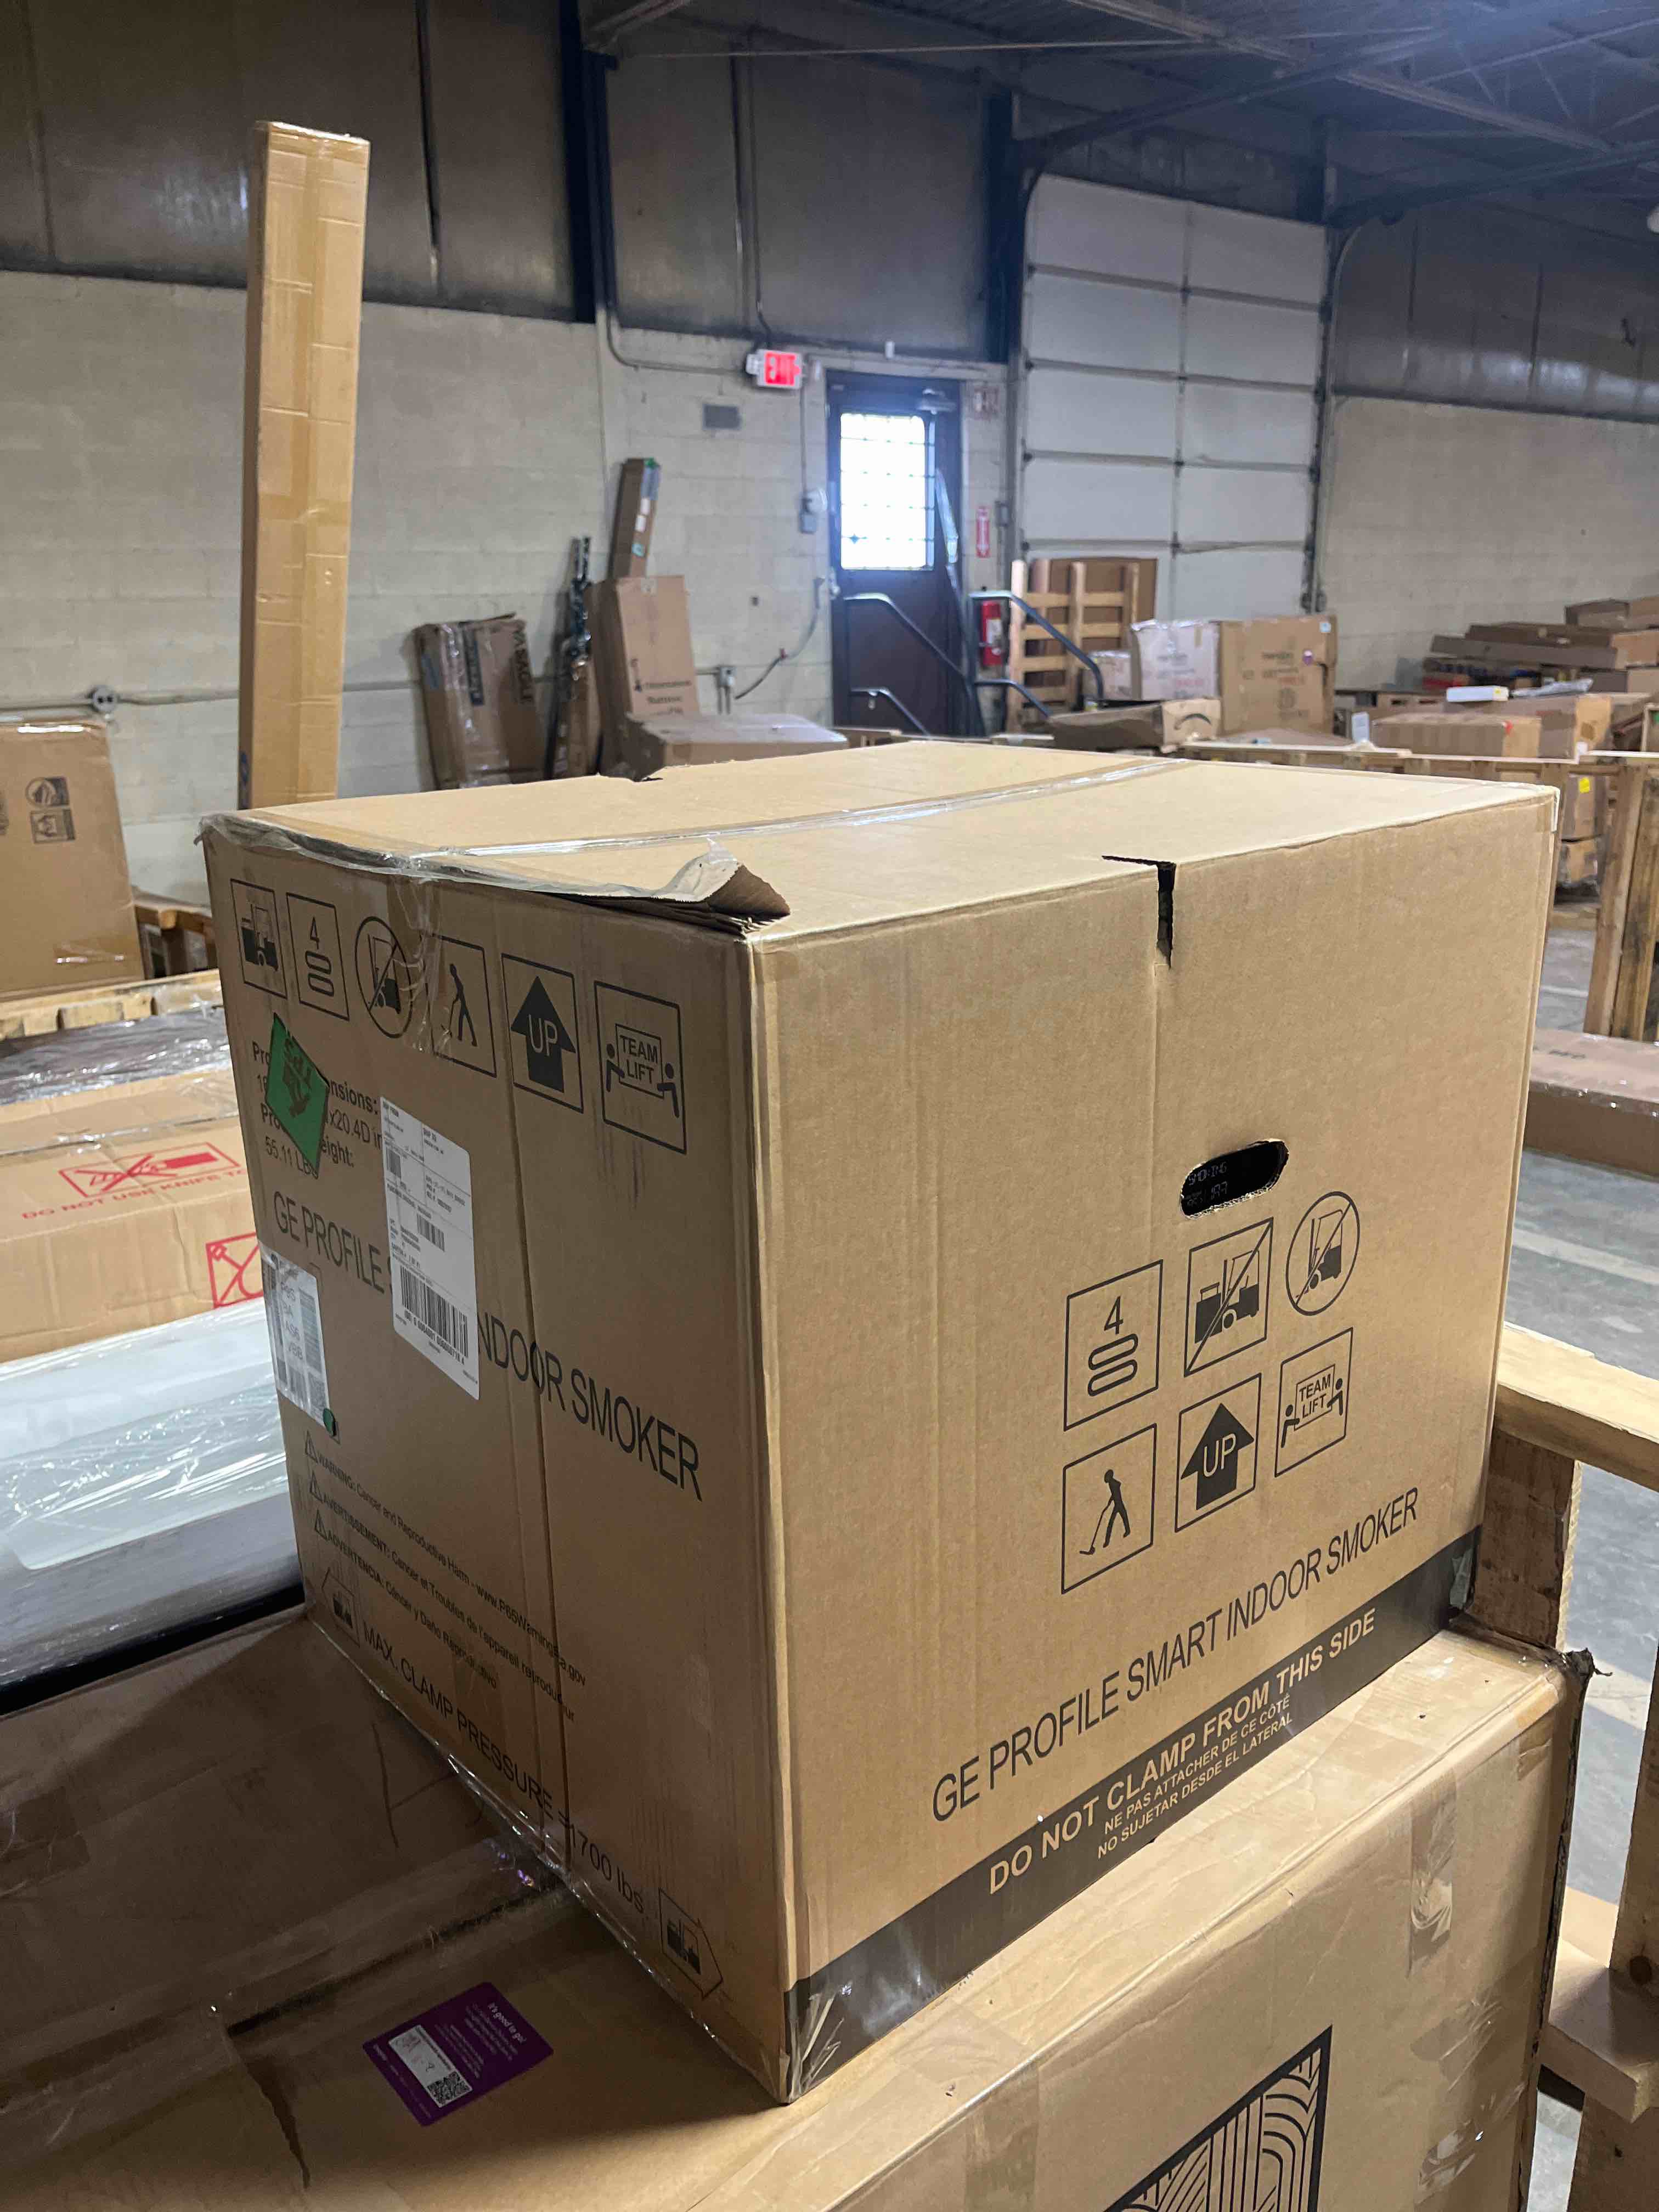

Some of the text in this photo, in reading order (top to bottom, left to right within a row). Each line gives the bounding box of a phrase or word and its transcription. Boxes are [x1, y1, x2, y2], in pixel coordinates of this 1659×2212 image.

[310, 917, 320, 950] 4
[528, 1014, 558, 1057] UP
[619, 1035, 658, 1064] TEAM
[626, 1059, 654, 1084] LIFT
[21, 1208, 54, 1220] DO
[61, 1198, 104, 1212] NOT
[112, 1188, 154, 1201] USE
[161, 1174, 220, 1192] KNIFE
[274, 1190, 300, 1243] GE
[301, 1205, 385, 1295] PROFILE
[1104, 1296, 1124, 1335] 4
[477, 1312, 566, 1412] NDOOR
[571, 1368, 703, 1503] SMOKER
[1299, 1373, 1331, 1401] TEAM
[1301, 1393, 1328, 1420] LIFT
[1202, 1433, 1237, 1479] UP
[448, 1555, 470, 1586] Harm
[933, 1487, 1419, 1822] GE PROFILE SMART INDOOR SMOKER
[363, 1619, 398, 1672] MAX.
[400, 1658, 454, 1720] CLAMP
[456, 1707, 554, 1820] PRESSURE
[616, 1864, 644, 1914] lbs
[989, 1607, 1376, 1895] DO NOT CLAMP FROM THIS SIDE
[1104, 1692, 1291, 1835] NE PAS ATTACHER DE CE CÔTÉ
[1097, 1711, 1294, 1859] NO SUJETAR DESDE EL LATERAL
